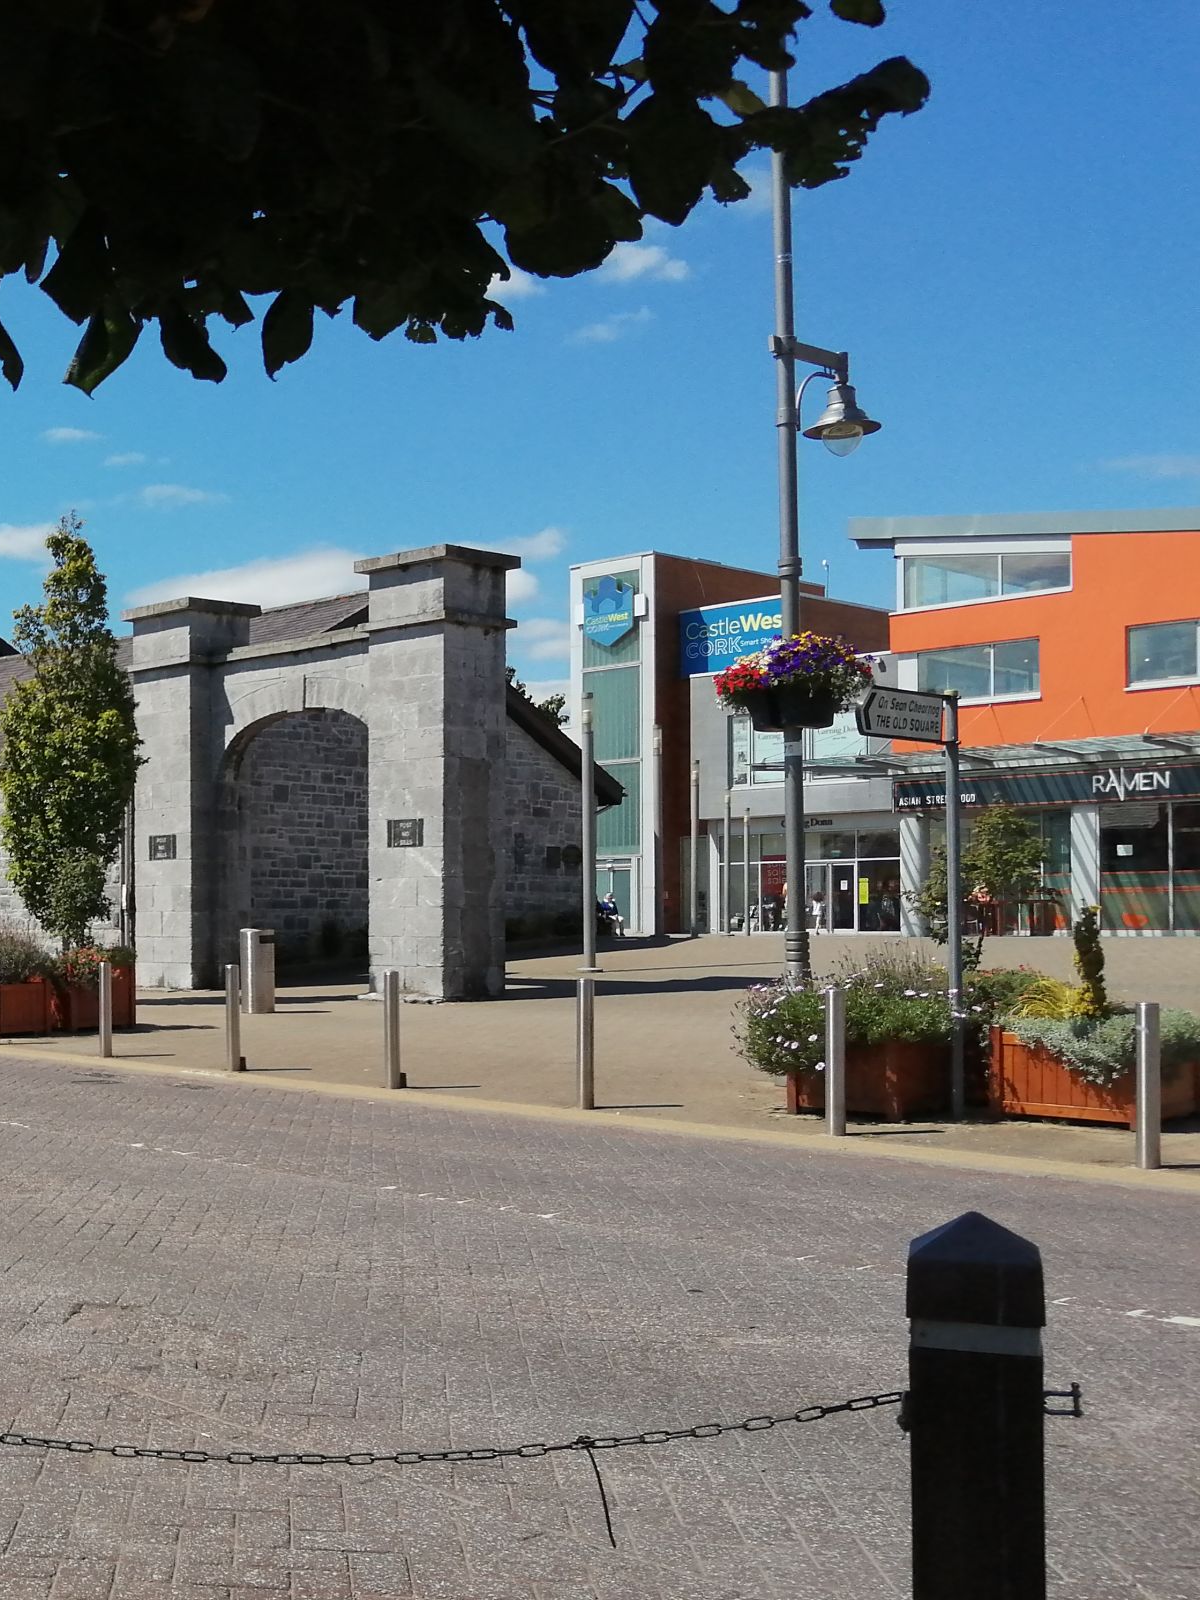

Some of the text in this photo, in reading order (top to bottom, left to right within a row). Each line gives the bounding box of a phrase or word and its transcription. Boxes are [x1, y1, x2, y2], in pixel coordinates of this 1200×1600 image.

[586, 612, 629, 625] CastleWest
[685, 612, 783, 640] CastleWes
[686, 636, 742, 659] CORK
[740, 639, 759, 647] Smart
[876, 715, 940, 734] THE OLD SQUARE
[1092, 768, 1170, 801] RAMEN
[898, 793, 976, 807] ASIAN STRE OOD
